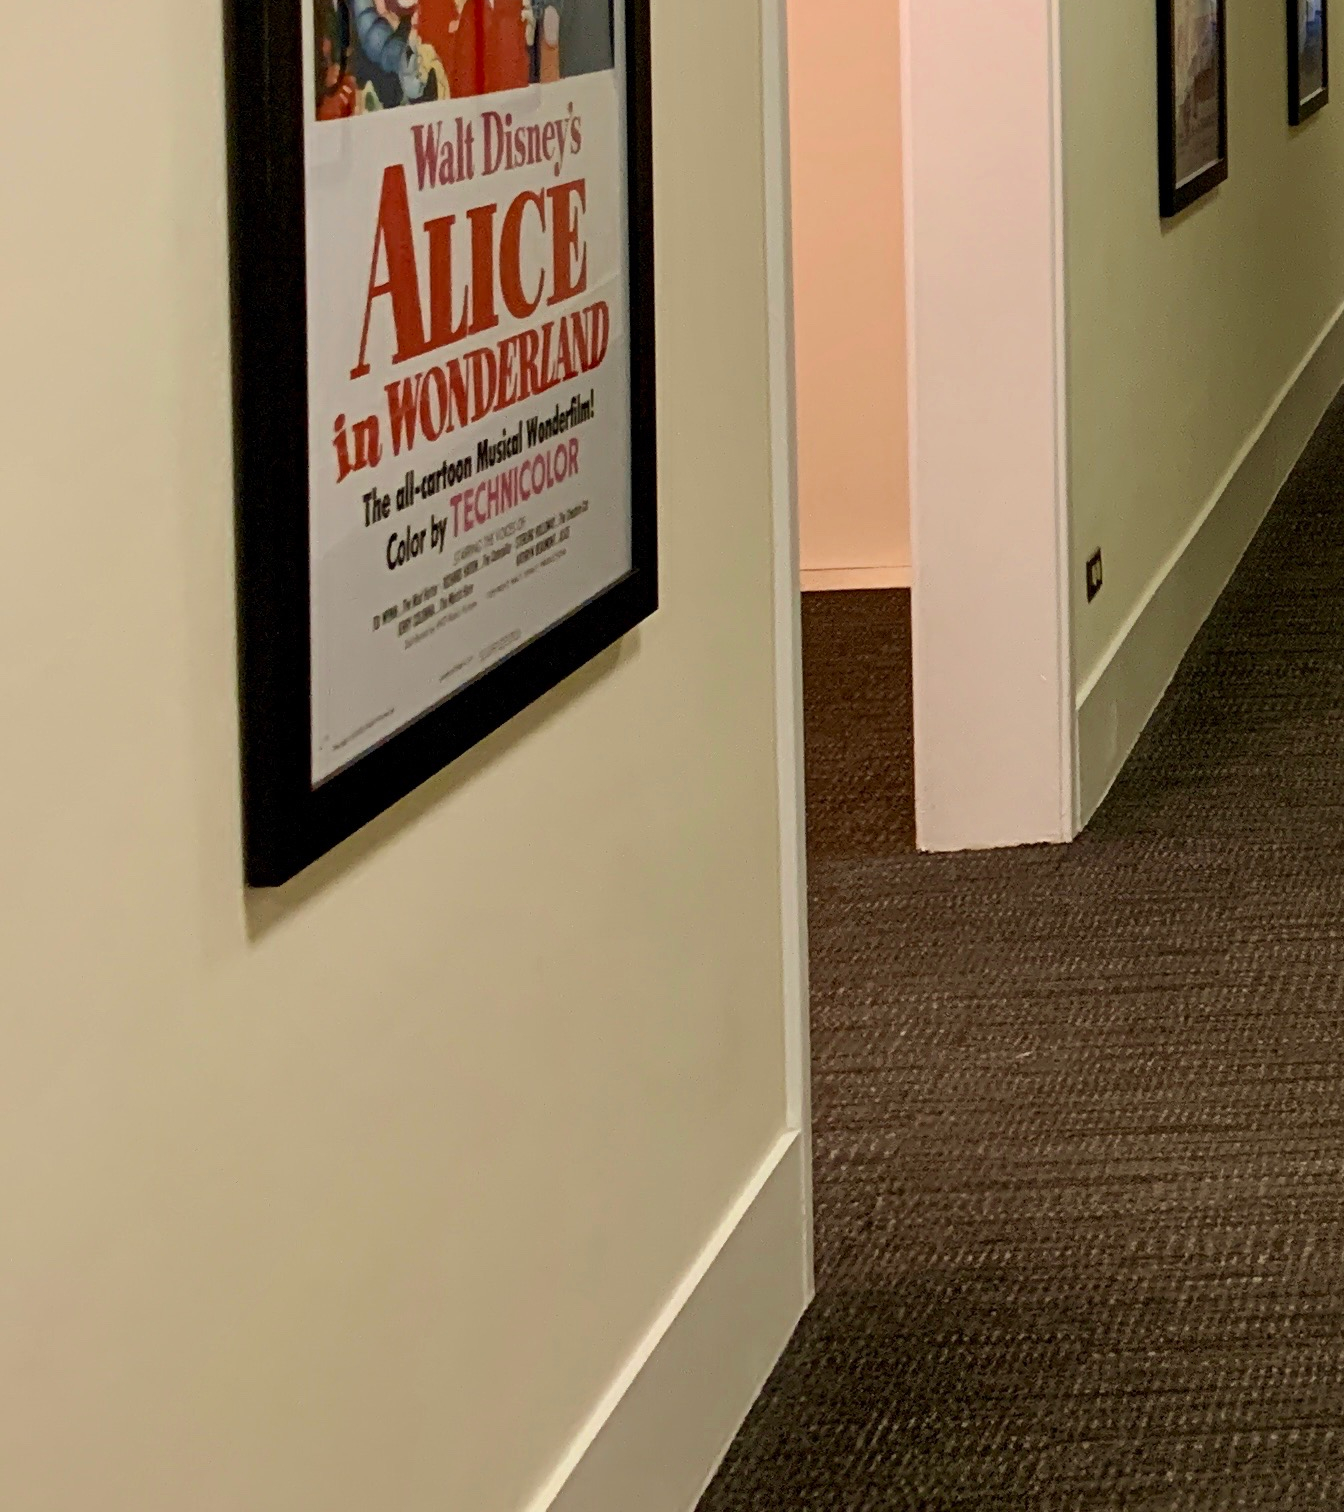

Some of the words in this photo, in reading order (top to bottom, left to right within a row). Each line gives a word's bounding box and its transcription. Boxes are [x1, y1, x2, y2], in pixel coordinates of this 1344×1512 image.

[411, 116, 474, 191] Walt
[481, 102, 582, 177] Disney's
[350, 164, 587, 380] ALICE
[333, 414, 383, 484] in
[384, 301, 609, 457] WONDERLAND
[362, 487, 391, 527] The
[396, 454, 472, 511] all-cartoon
[476, 420, 523, 474] Musical
[526, 389, 594, 448] Wonderfilm!
[386, 525, 427, 570] Color
[430, 514, 448, 554] by
[450, 437, 580, 538] TECHNICOLOR
